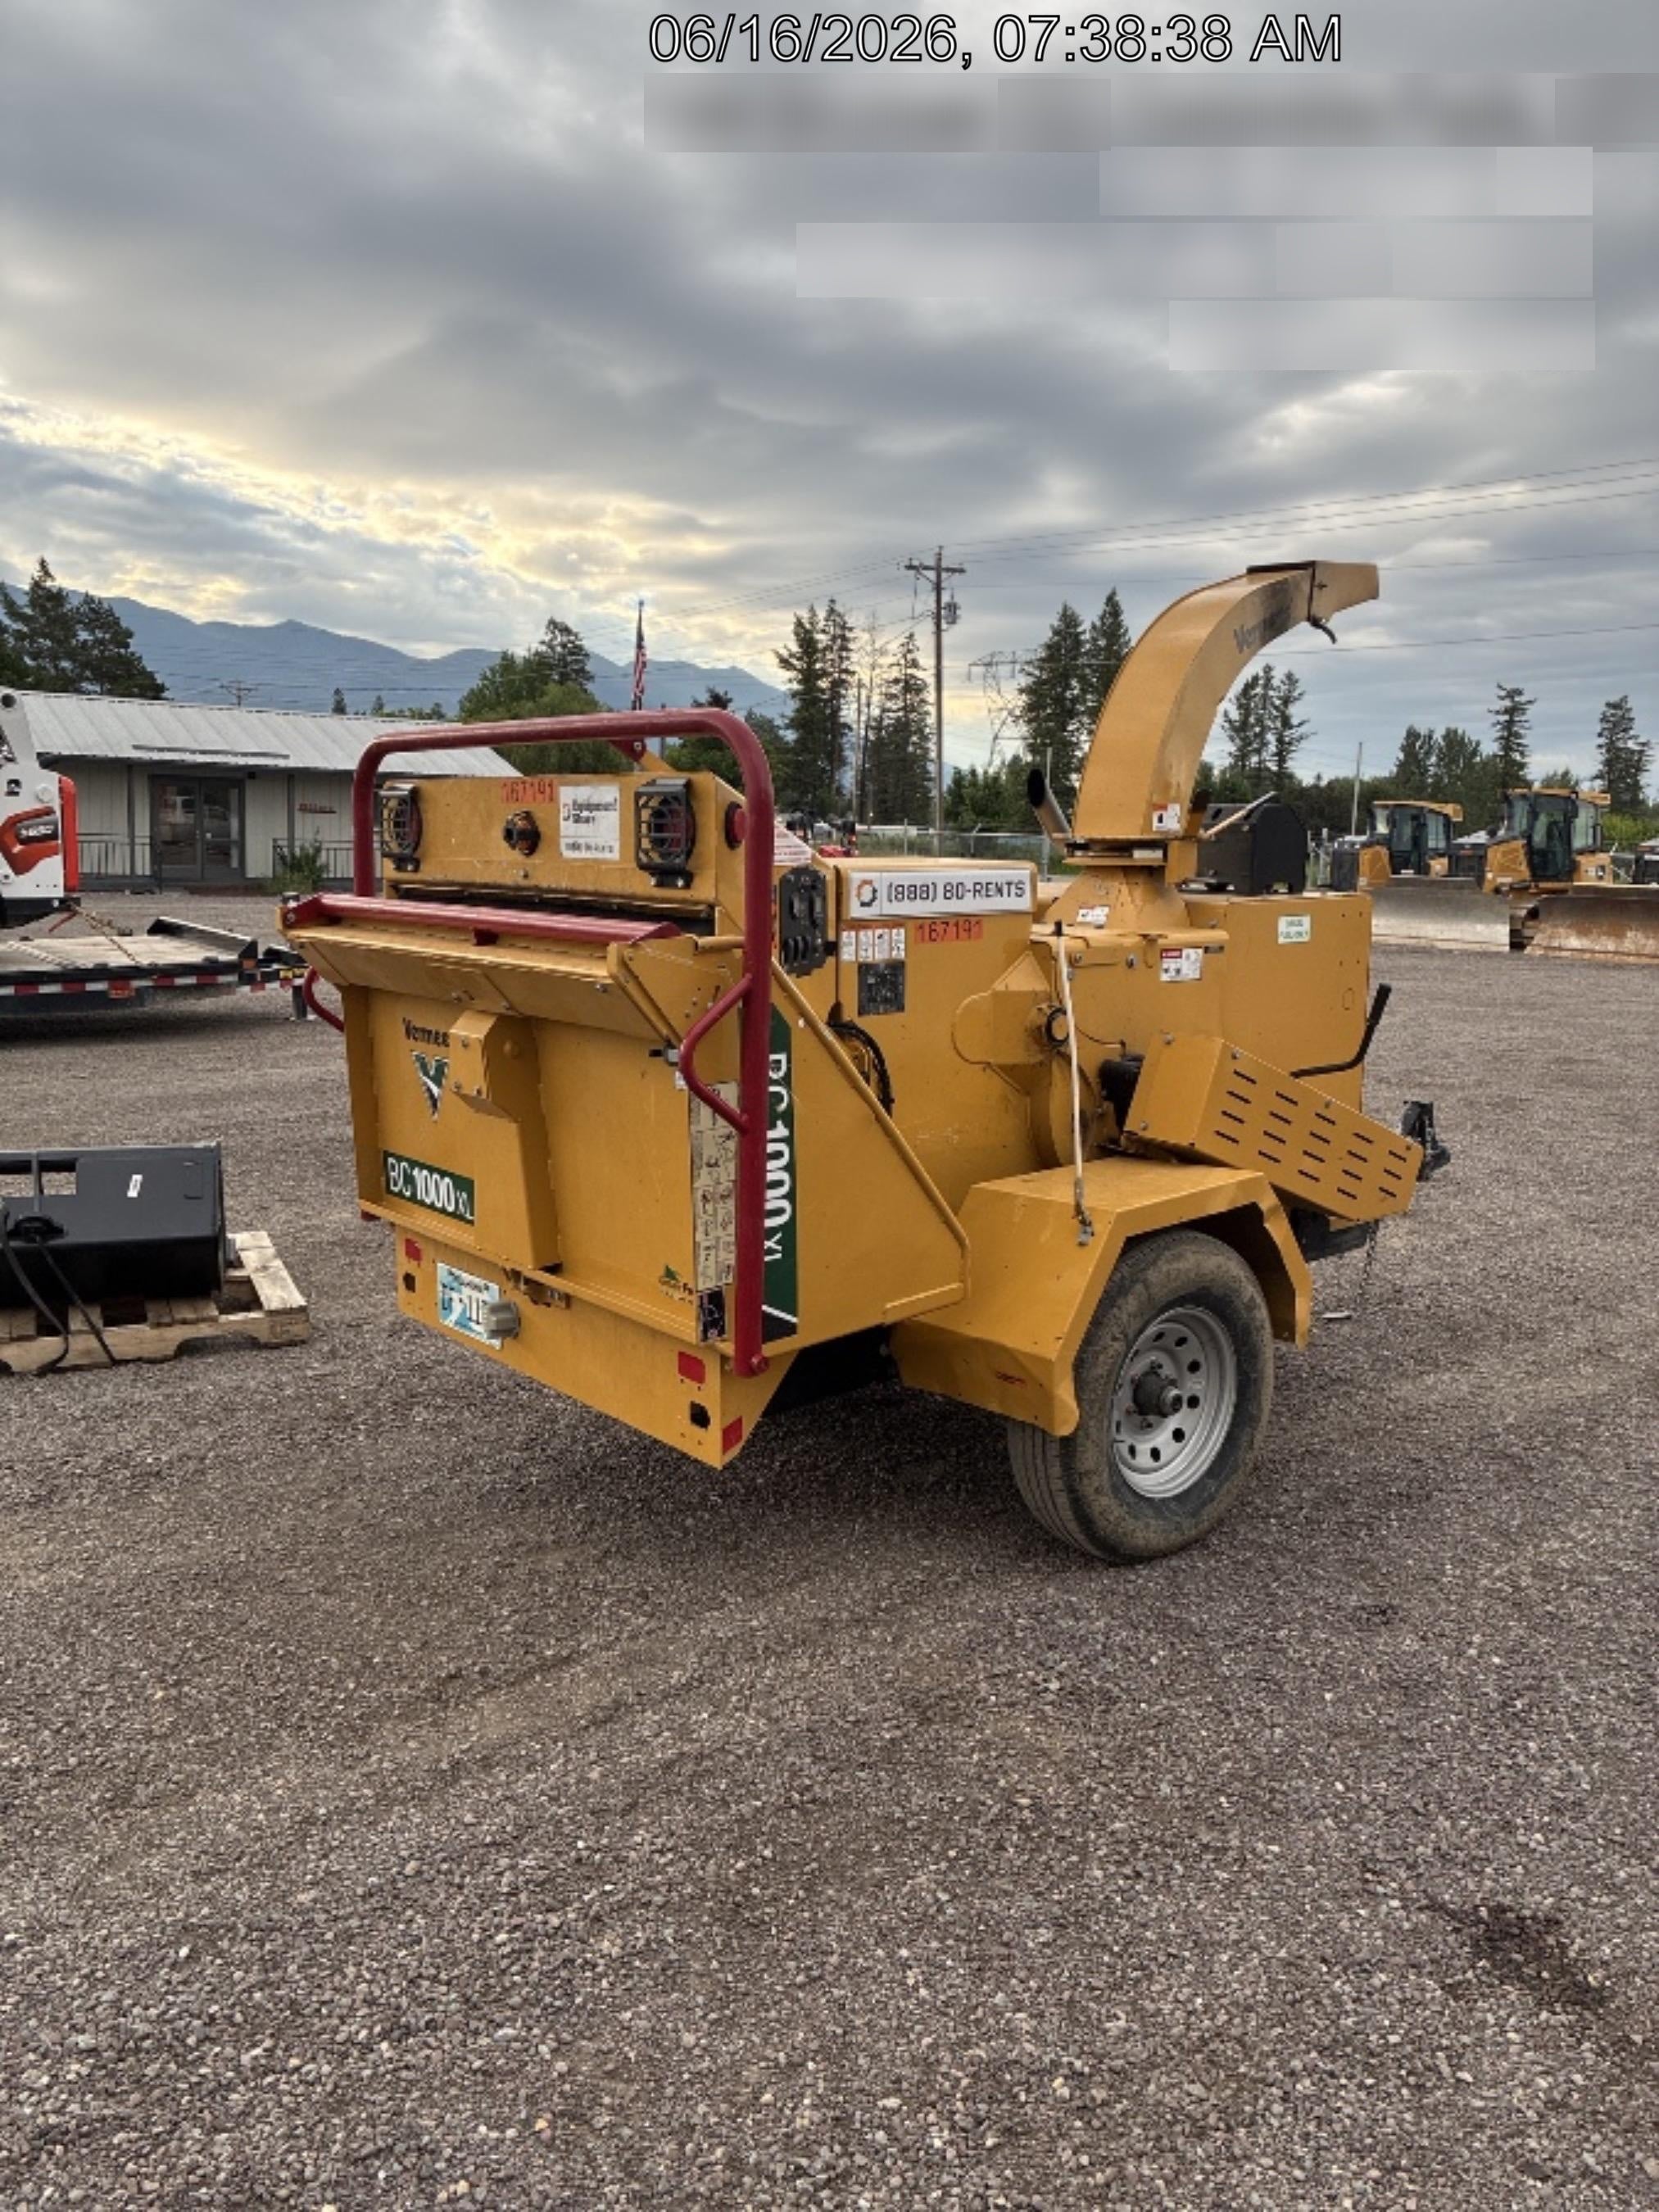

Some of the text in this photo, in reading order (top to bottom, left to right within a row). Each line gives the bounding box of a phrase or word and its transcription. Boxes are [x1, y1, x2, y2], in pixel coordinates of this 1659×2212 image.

[886, 880, 1026, 903] (888) 80-RENTS
[916, 918, 983, 942] 167191
[401, 1017, 450, 1048] Vermee
[388, 1157, 411, 1198] BC
[412, 1167, 455, 1213] 1000
